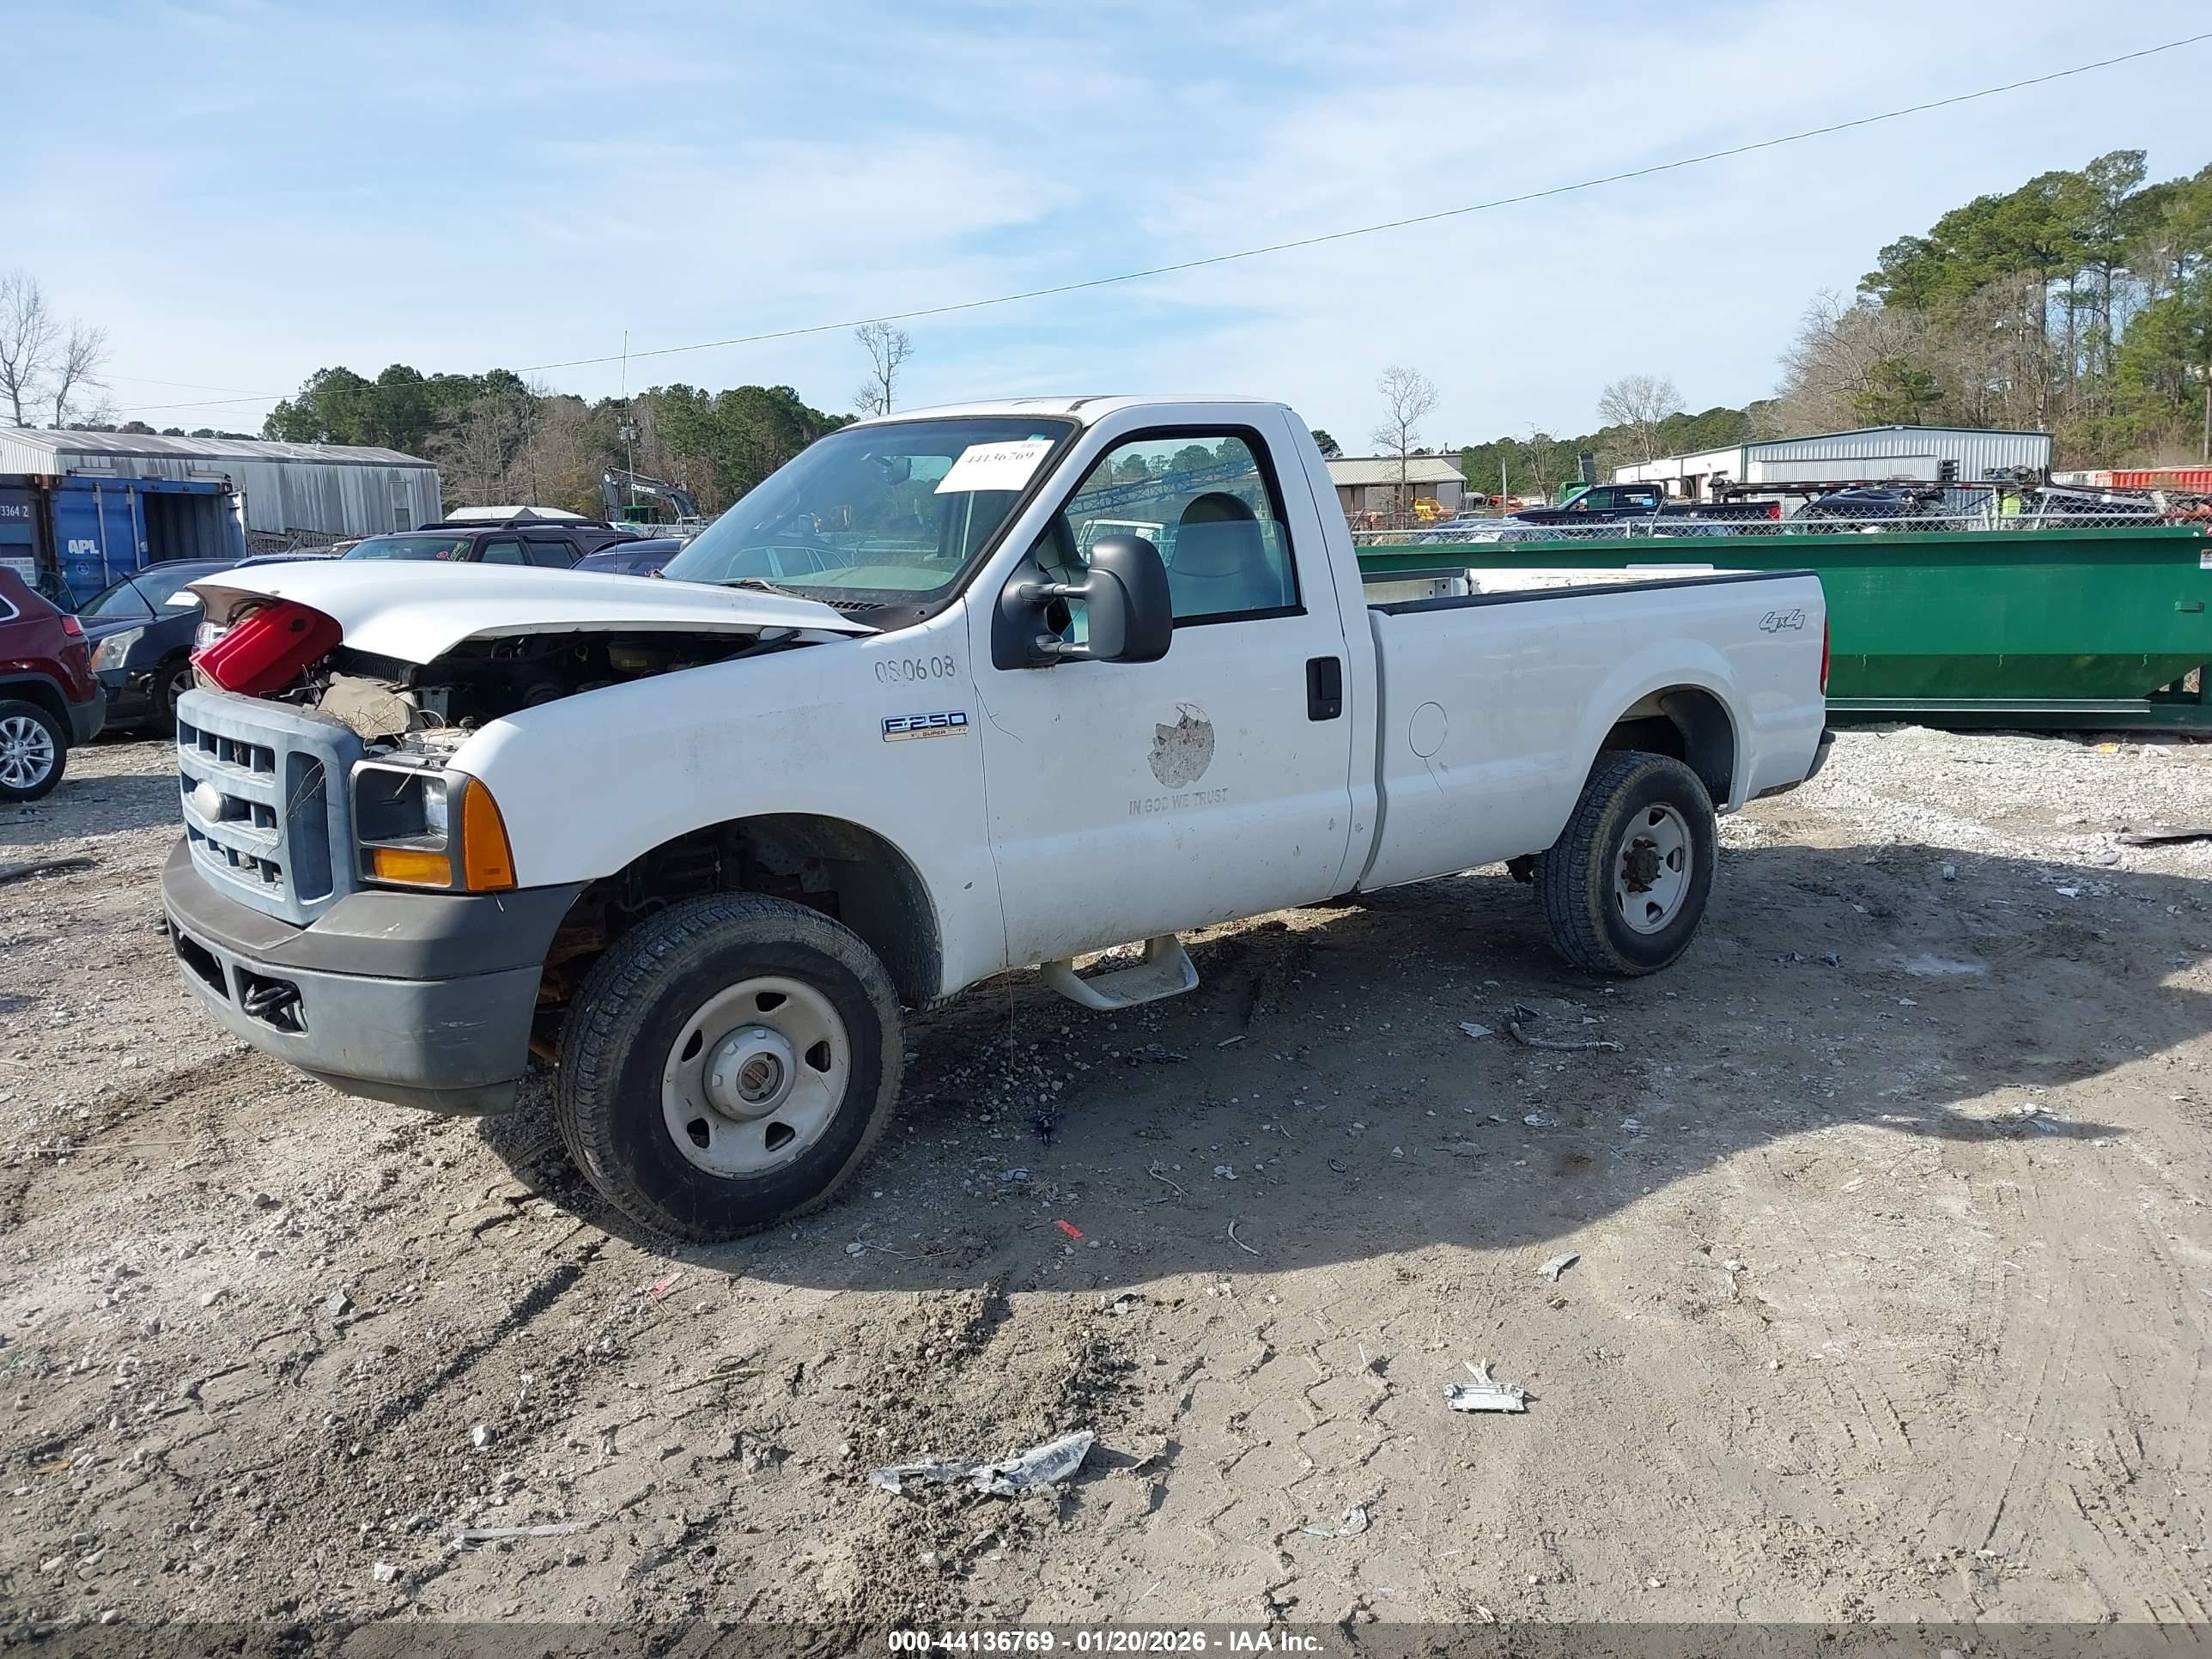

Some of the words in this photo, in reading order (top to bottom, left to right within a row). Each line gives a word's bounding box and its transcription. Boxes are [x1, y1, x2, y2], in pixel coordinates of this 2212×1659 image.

[631, 483, 657, 495] DEERE
[68, 539, 100, 555] APL
[1128, 799, 1141, 816] IN
[1145, 796, 1169, 813] GOD
[1172, 793, 1189, 808] WE
[1192, 787, 1229, 805] TRUST
